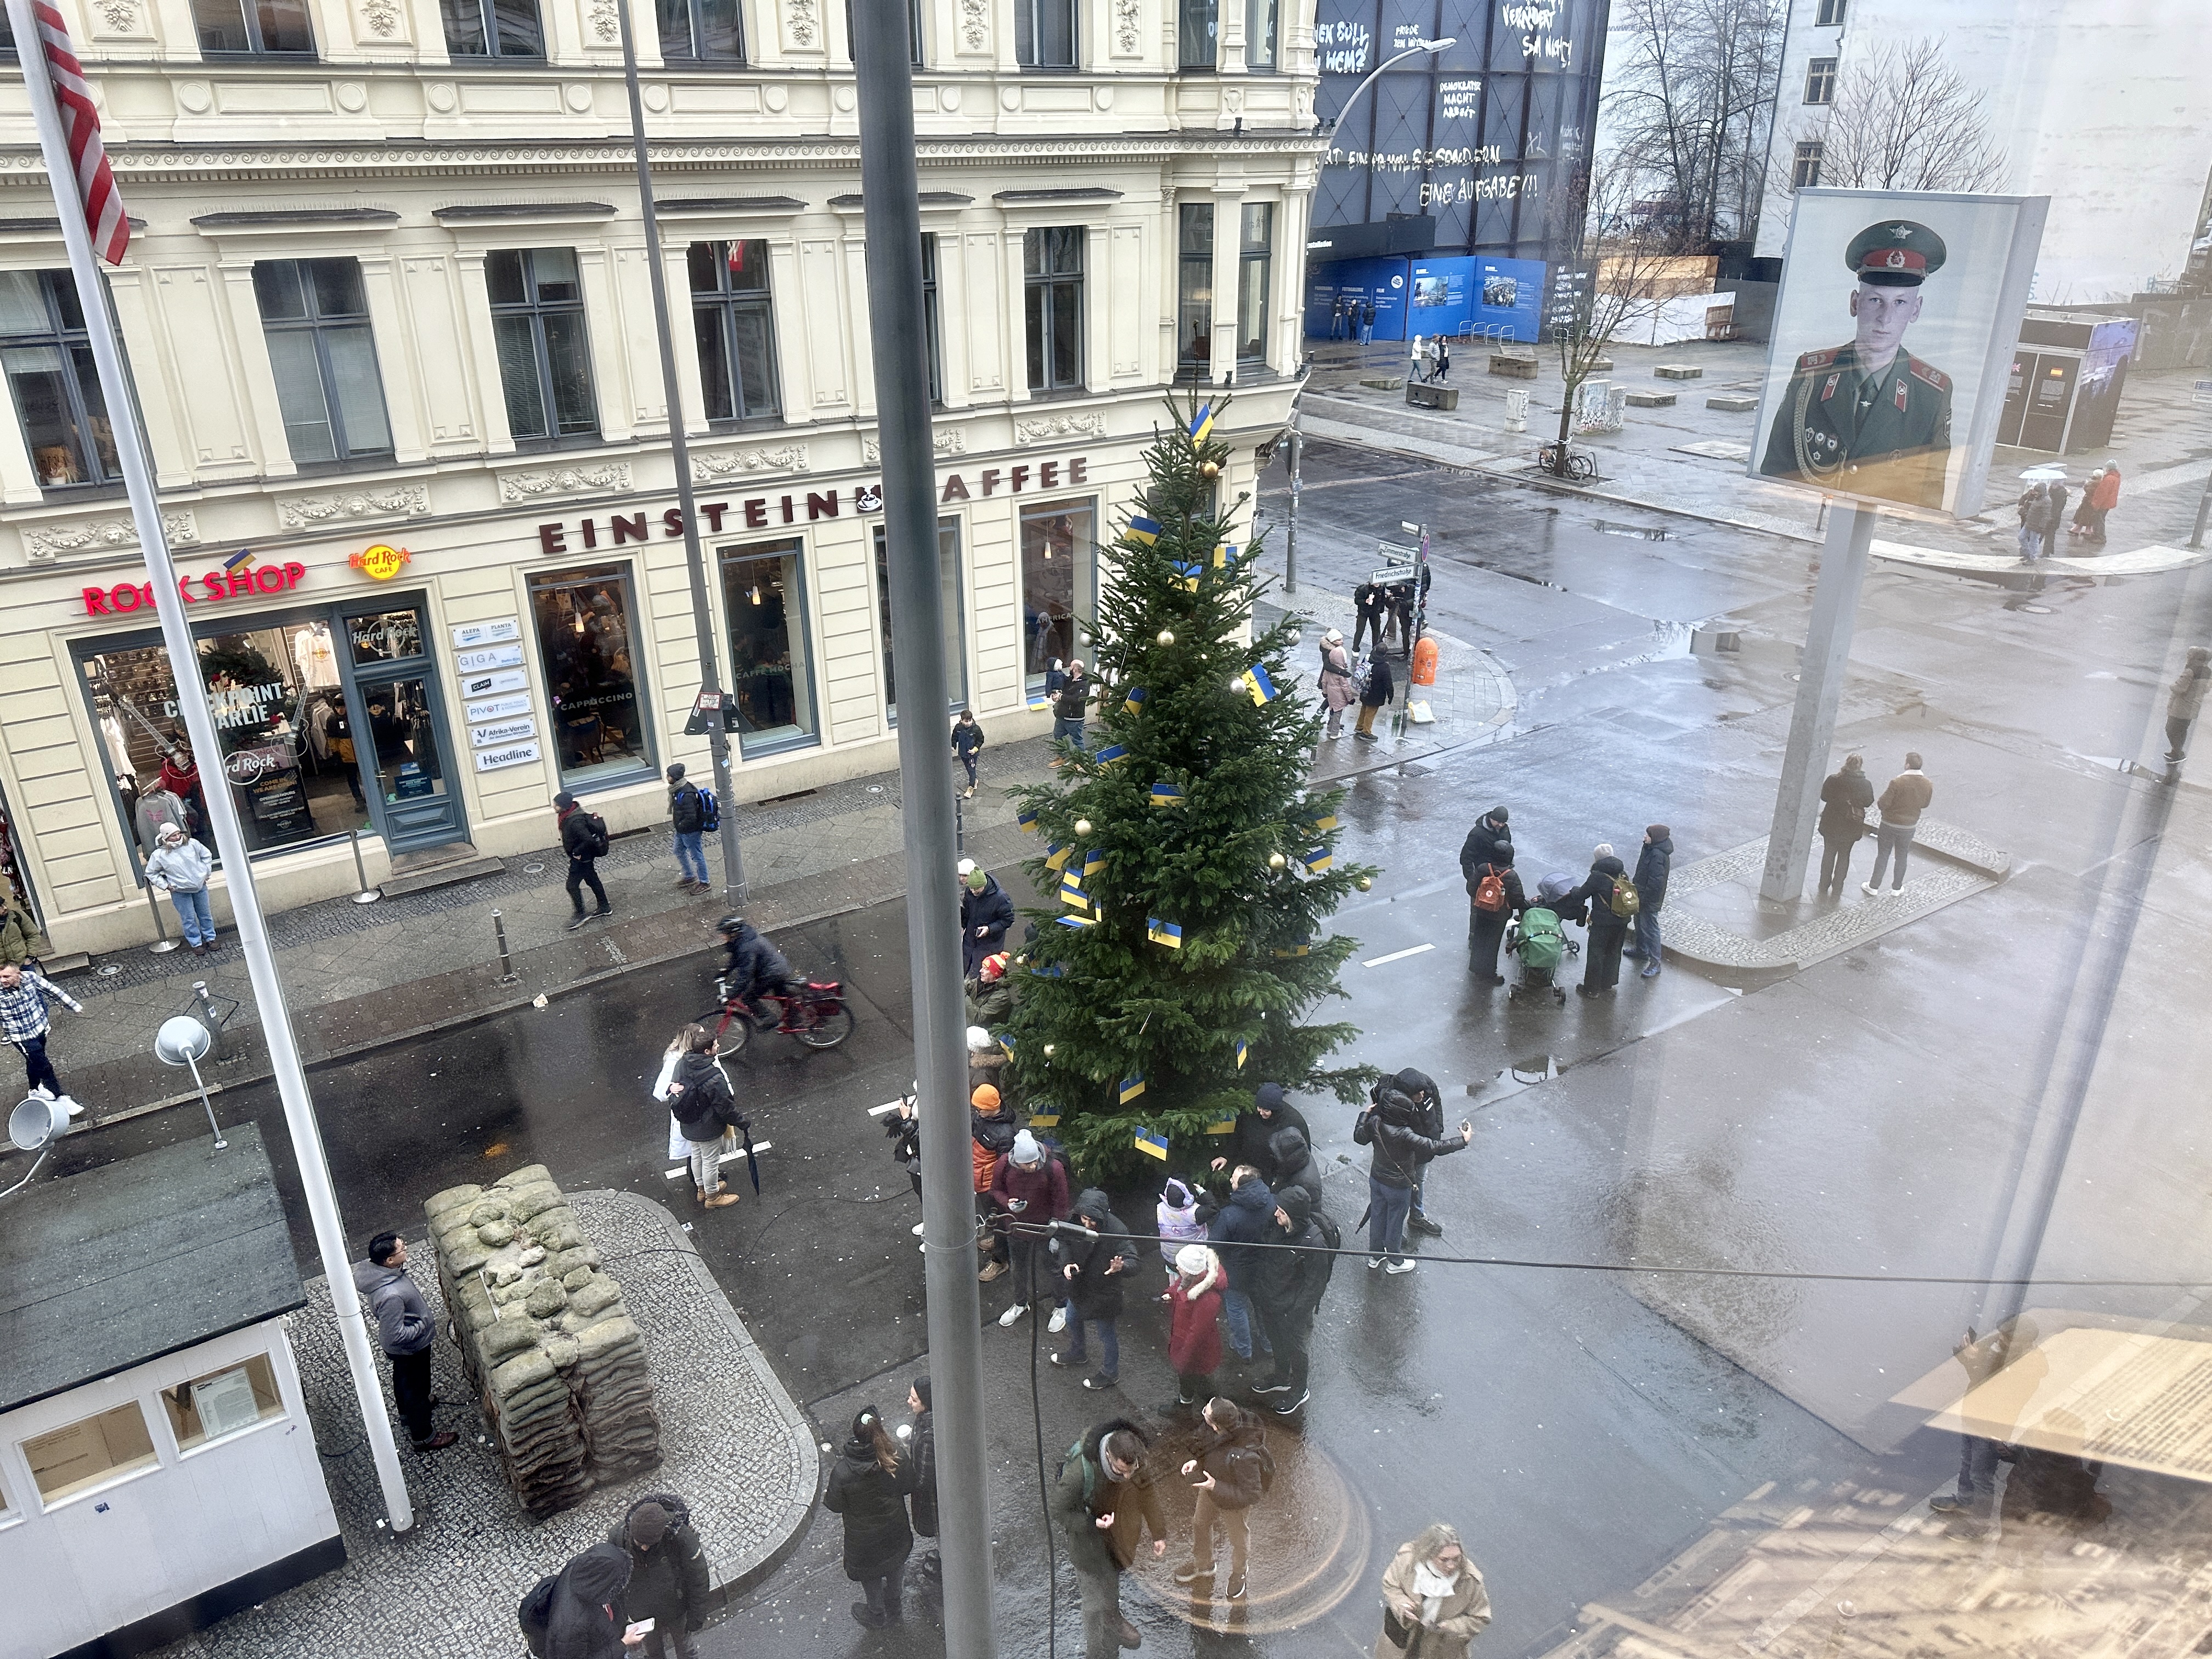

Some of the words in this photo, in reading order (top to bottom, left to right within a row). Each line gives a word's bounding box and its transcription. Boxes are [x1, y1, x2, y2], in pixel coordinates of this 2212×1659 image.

[1326, 48, 1366, 74] WEM?
[1419, 182, 1454, 206] EINE
[539, 489, 839, 554] EINSTEIN
[941, 457, 1087, 502] AFFEE
[348, 552, 379, 568] Hard
[382, 548, 411, 565] Rock
[1384, 545, 1411, 560] Zimmerstraße
[204, 562, 306, 601] SHOP
[1375, 568, 1412, 579] Friedrichstraße
[352, 628, 384, 644] Hard
[386, 623, 419, 641] Rock
[770, 662, 805, 673] MOCHA
[473, 680, 490, 690] CLAIM
[470, 704, 500, 715] PIVOT
[561, 692, 633, 711] CAPPUCCINO
[218, 704, 270, 730] ARLIE
[489, 724, 530, 736] Afrika-Verein
[225, 759, 240, 774] rd
[242, 754, 275, 772] Rock
[483, 749, 532, 765] Headline
